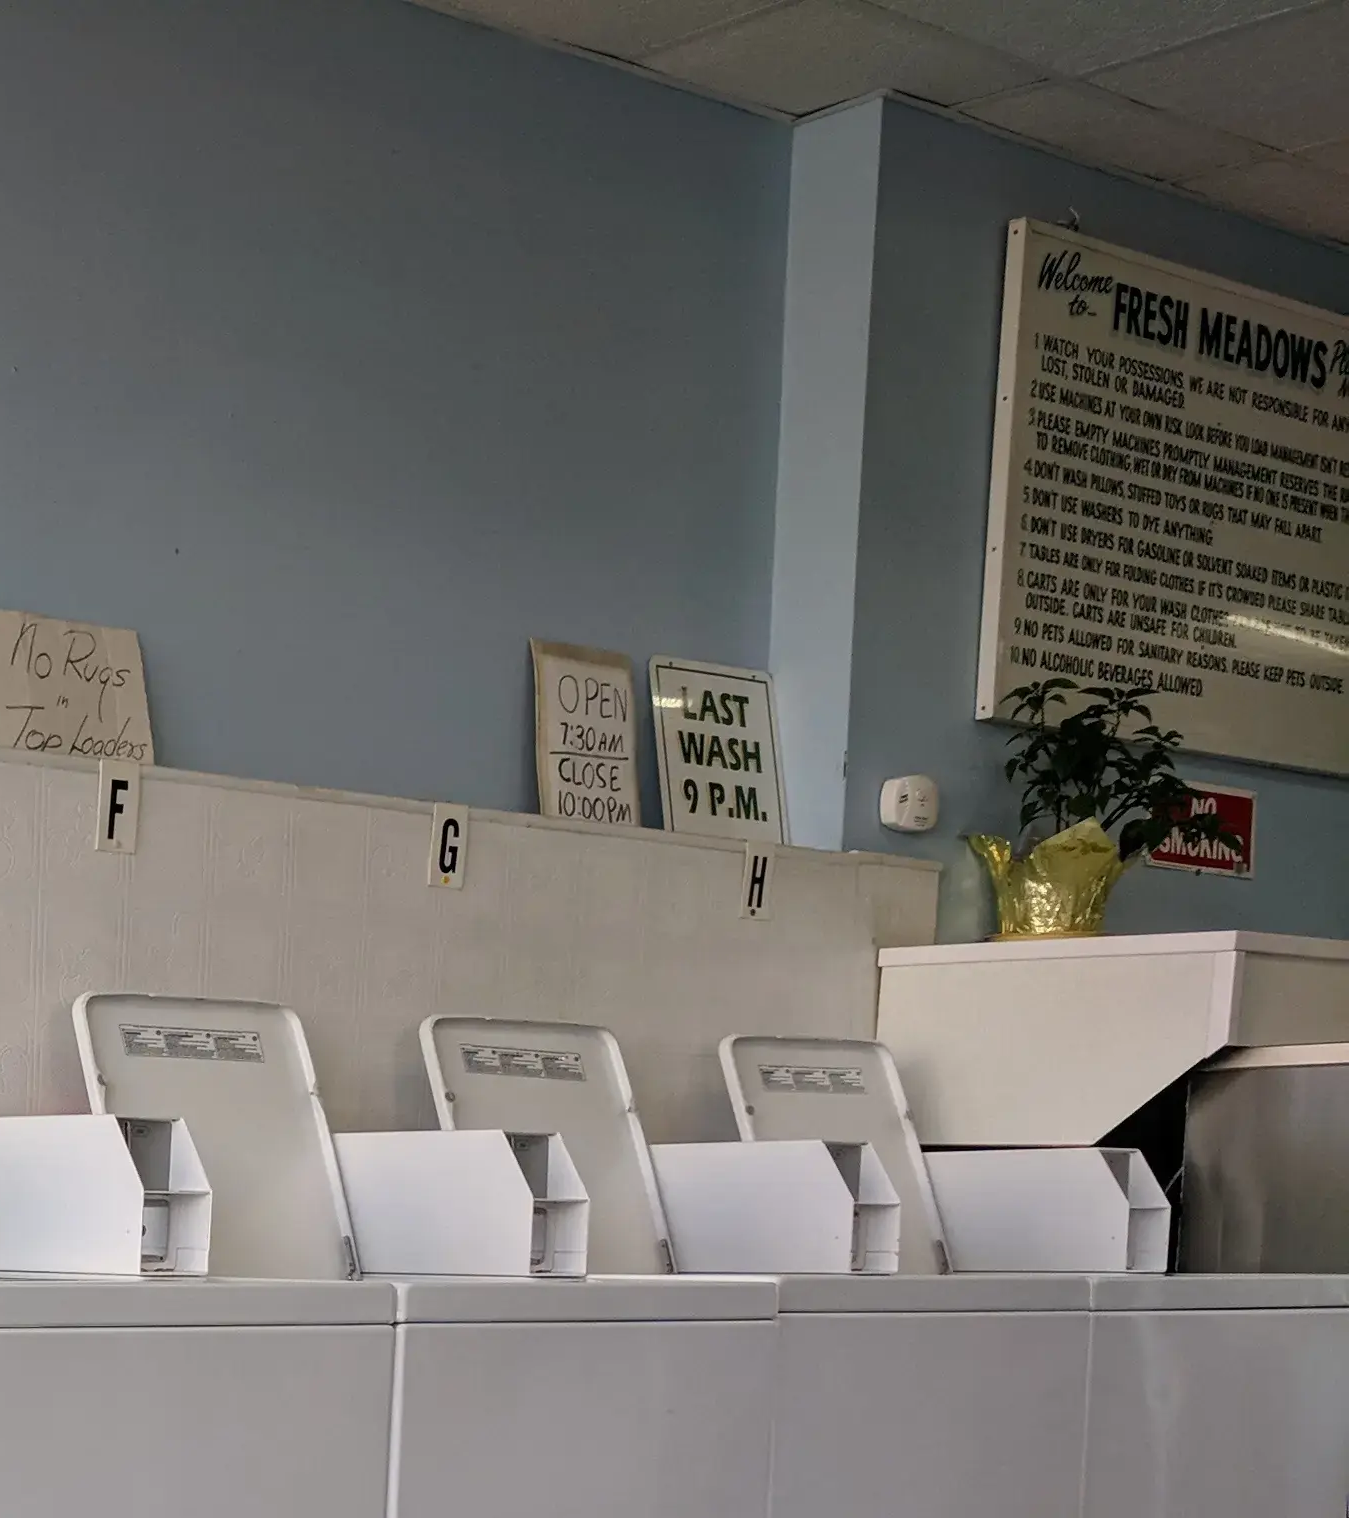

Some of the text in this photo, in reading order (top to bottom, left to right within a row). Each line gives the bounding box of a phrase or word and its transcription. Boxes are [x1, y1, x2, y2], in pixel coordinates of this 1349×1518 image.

[1038, 250, 1113, 294] Welcome
[1112, 282, 1190, 350] FRESH
[1198, 307, 1329, 389] MEADOWS
[1040, 354, 1069, 380] LOST,
[1072, 362, 1109, 390] STOLEN
[1114, 373, 1128, 395] OR
[1042, 334, 1079, 360] WATCH
[1085, 345, 1115, 370] YOUR
[1188, 374, 1203, 394] WE
[1205, 378, 1224, 400] ARE
[1228, 384, 1248, 406] NOT
[1251, 391, 1308, 423] RESPONSIBLE
[1312, 407, 1328, 428] FOR
[1060, 494, 1078, 515] USE
[1080, 499, 1122, 525] WASHERS
[1127, 510, 1139, 529] TO
[1142, 513, 1160, 533] DYE
[1024, 592, 1069, 616] OUTSIDE.
[1071, 601, 1103, 623] CARTS
[1106, 608, 1126, 628] ARE
[1129, 612, 1166, 635] UNSAFE
[1171, 620, 1189, 640] FOR
[10, 623, 130, 723] No Rugs
[1021, 646, 1037, 667] NO
[1039, 650, 1094, 677] ALCOHOLIC
[1097, 660, 1153, 688] BEVERAGES
[1023, 619, 1038, 638] NO
[1041, 622, 1064, 643] PETS
[1067, 627, 1112, 652] ALLOWED
[1116, 636, 1134, 656] FOR
[1138, 640, 1183, 665] SANITARY
[1231, 658, 1260, 679] PLEASE
[1263, 664, 1283, 683] KEEP
[1286, 668, 1305, 687] PETS
[57, 696, 69, 708] in
[558, 674, 628, 722] OPEN
[682, 686, 749, 728] LAST
[6, 706, 147, 760] Top Loaders
[678, 730, 762, 773] WASH
[558, 757, 622, 792] CLOSE
[106, 779, 128, 841] F
[683, 778, 768, 822] 9 P.M.
[1190, 797, 1217, 818] NO
[438, 818, 461, 874] G
[746, 855, 770, 909] H
